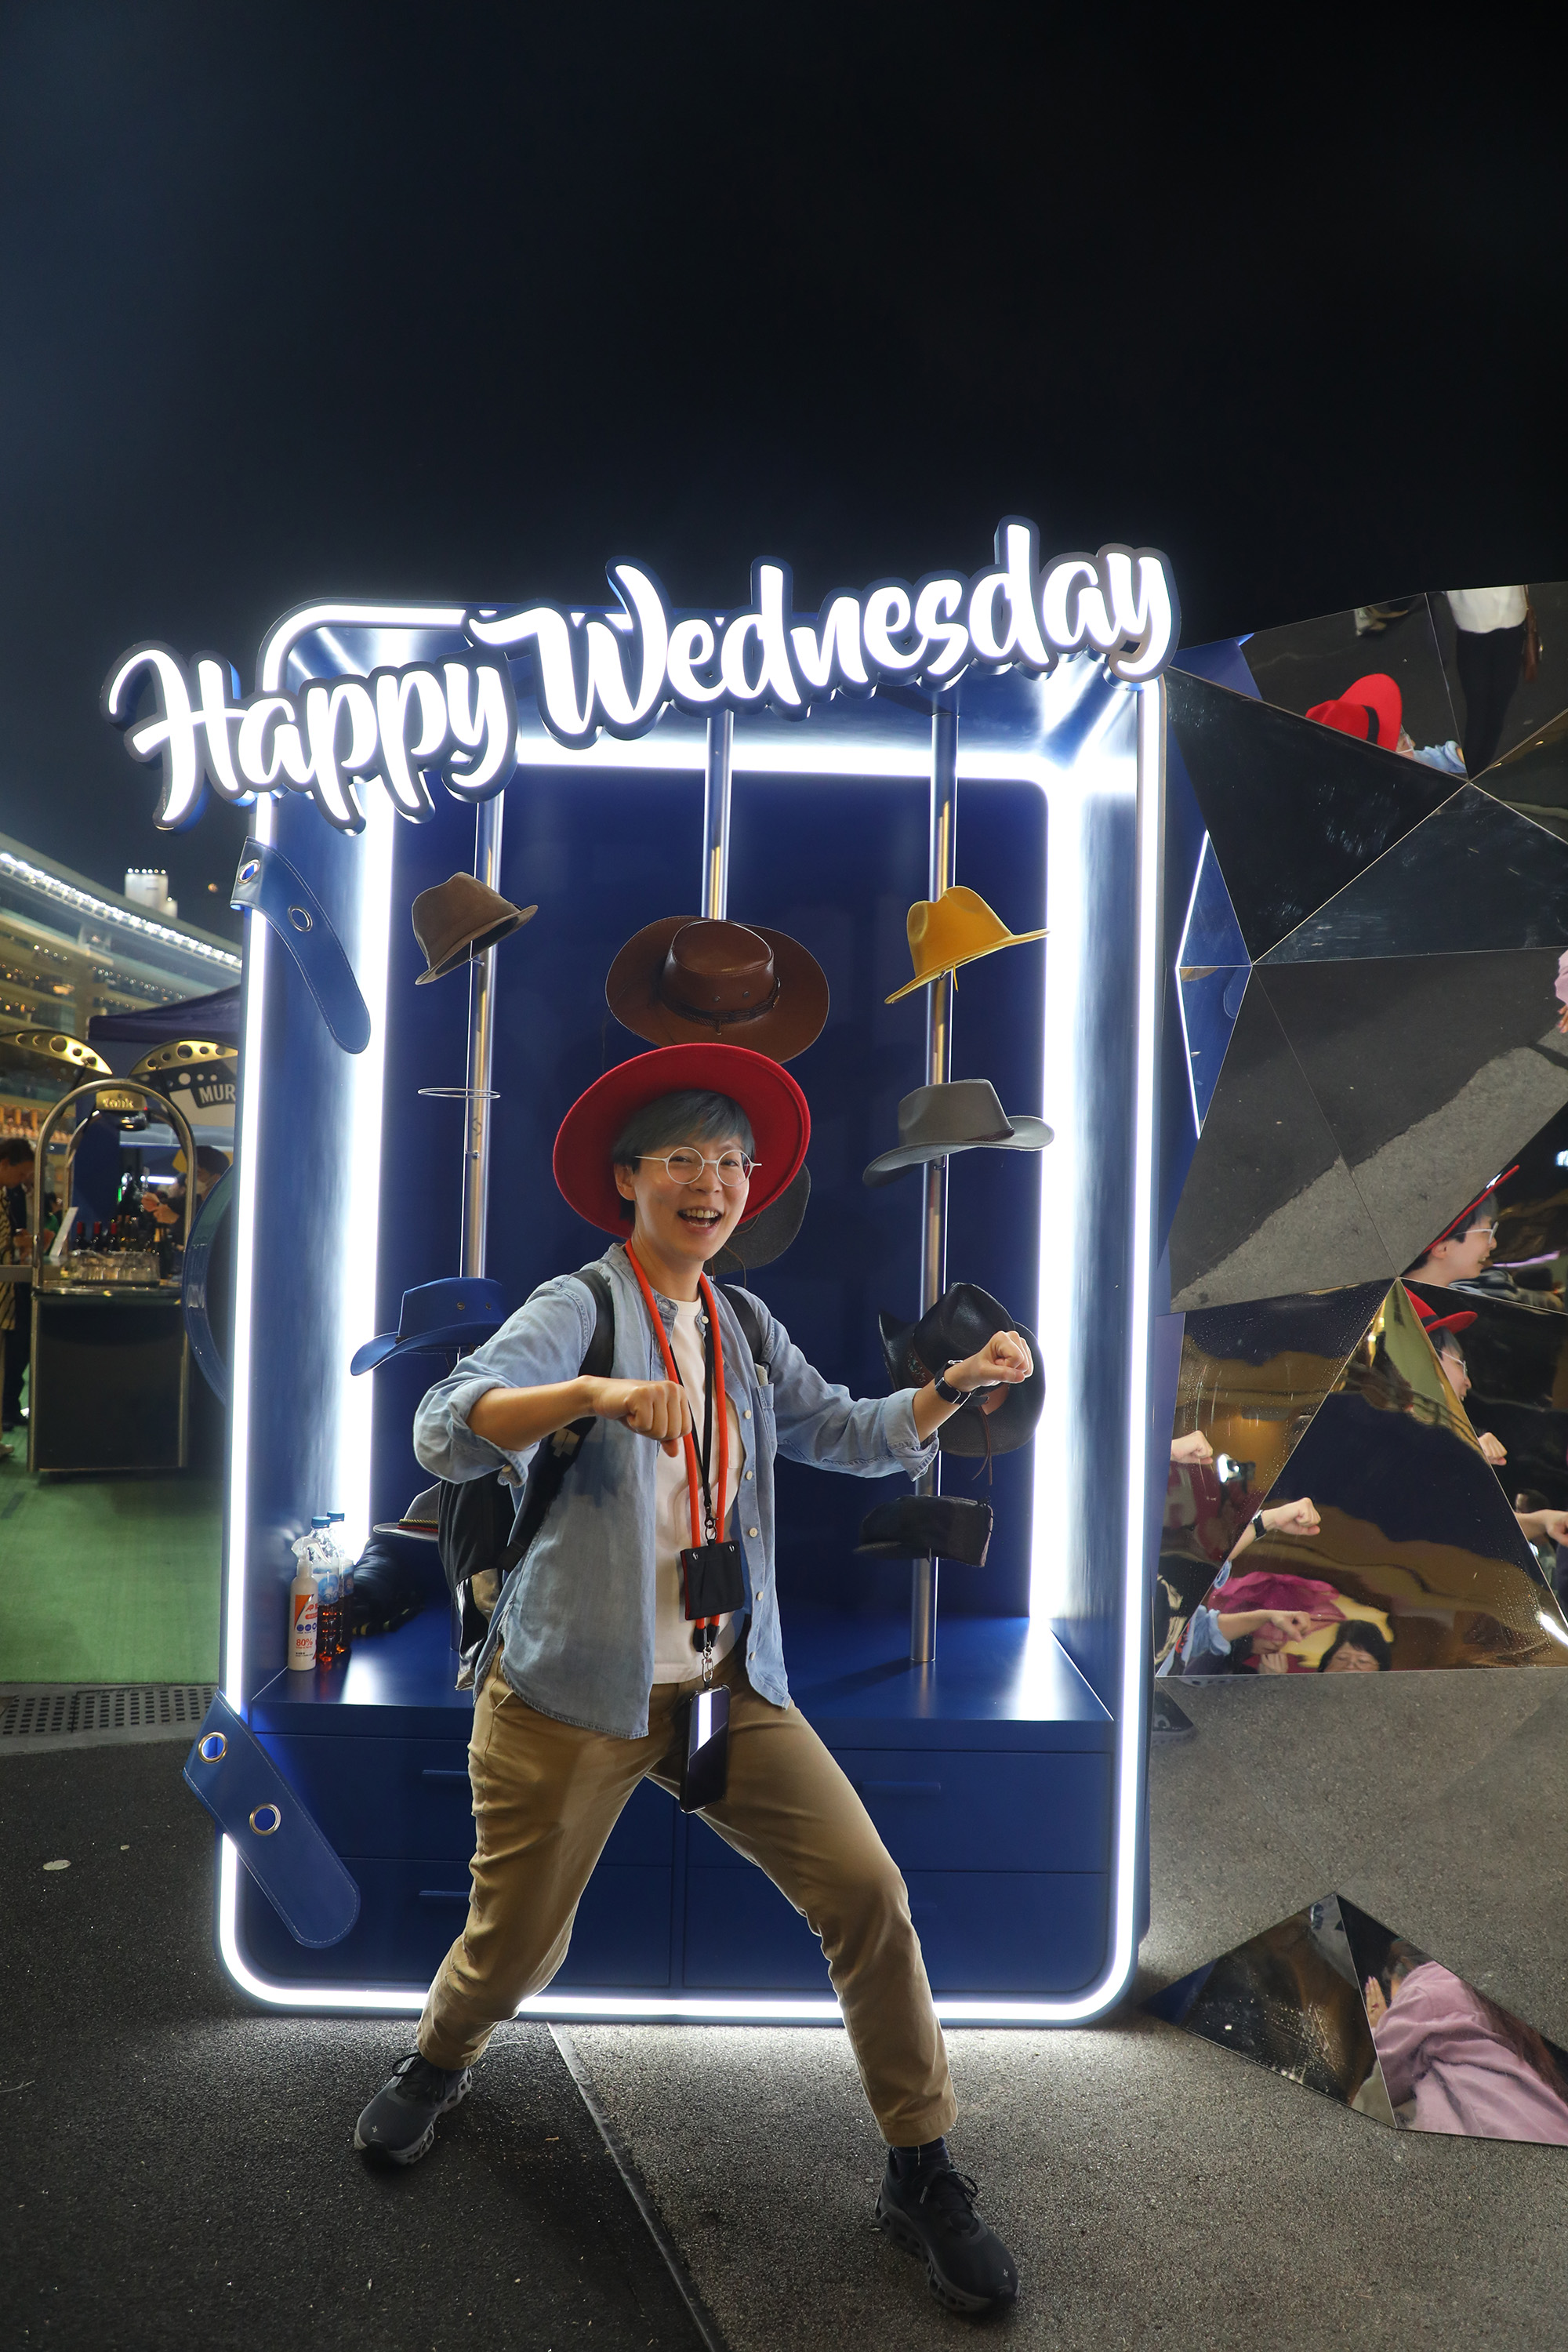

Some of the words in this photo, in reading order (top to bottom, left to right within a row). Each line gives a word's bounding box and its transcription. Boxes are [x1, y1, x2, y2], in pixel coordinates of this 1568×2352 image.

[104, 644, 514, 827] Happy
[470, 519, 1171, 742] Wednesday
[198, 1083, 236, 1104] MUR
[296, 1637, 313, 1646] 80%
